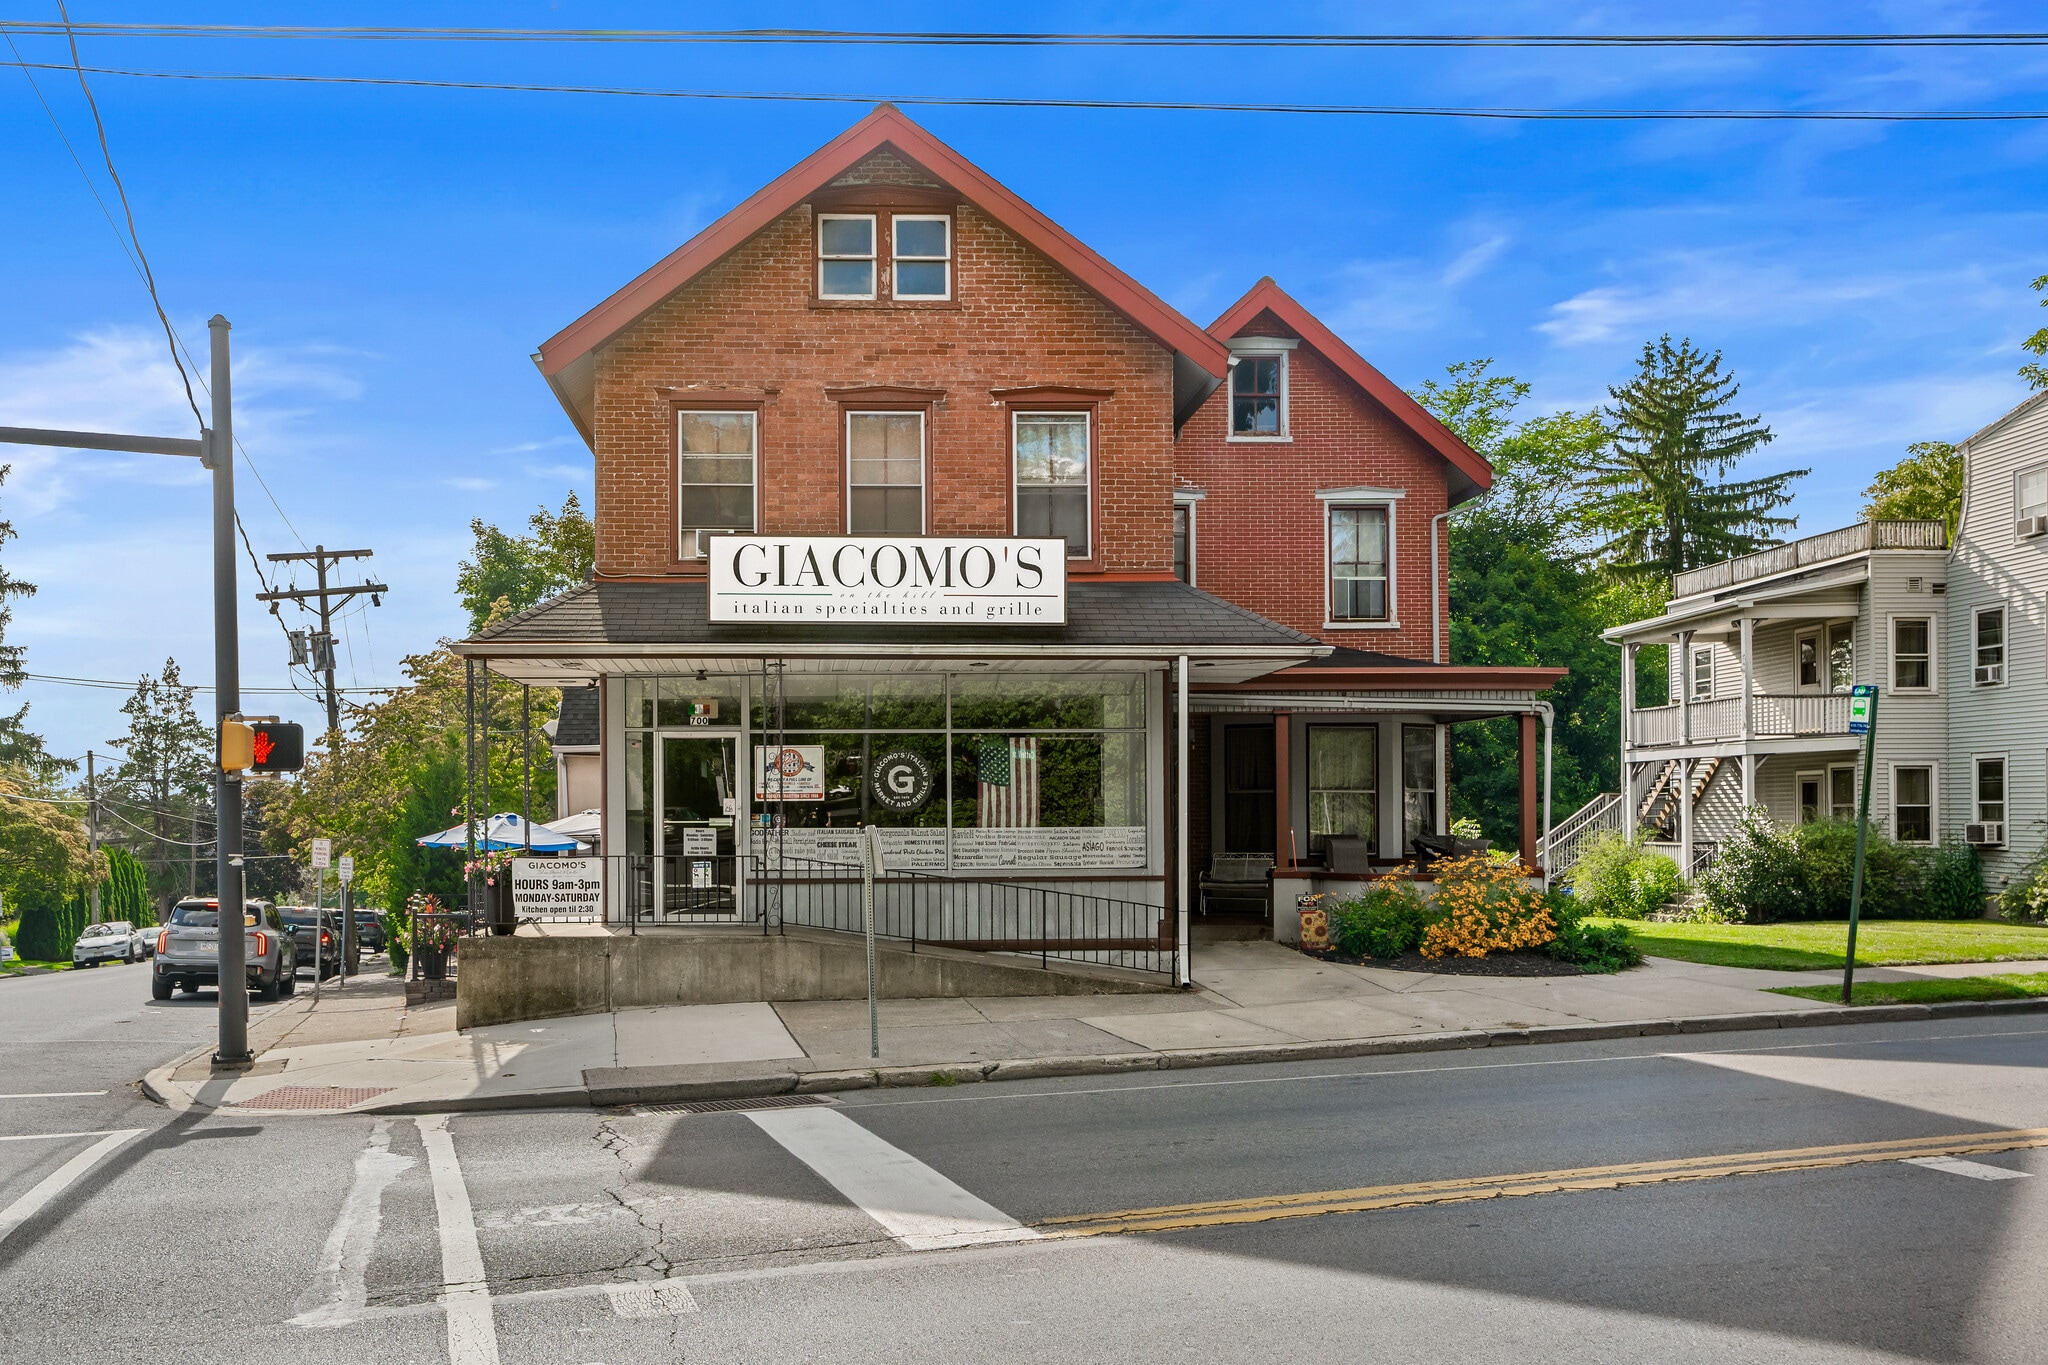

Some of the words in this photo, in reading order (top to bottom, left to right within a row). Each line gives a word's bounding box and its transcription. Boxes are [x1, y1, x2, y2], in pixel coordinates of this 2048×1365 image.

[732, 543, 1043, 588] GIACOMO'S
[867, 591, 891, 599] the
[902, 590, 937, 599] hill
[734, 600, 803, 614] italian
[815, 600, 928, 618] specialties
[939, 602, 974, 615] and
[986, 602, 1042, 619] grille
[690, 717, 708, 725] 700
[874, 752, 905, 778] GIACOMO'S
[906, 752, 928, 777] ITALIAN
[888, 765, 915, 793] G
[874, 782, 895, 806] MARKET
[912, 781, 928, 803] GRILLE
[528, 861, 587, 869] GIACOMO'S
[515, 879, 549, 890] HOURS
[552, 879, 600, 892] 9am-3pm
[515, 893, 600, 903] MONDAY-SATURDAY
[521, 905, 548, 913] Kitchen
[549, 906, 567, 914] open
[568, 905, 577, 913] til
[578, 905, 594, 913] 2:30
